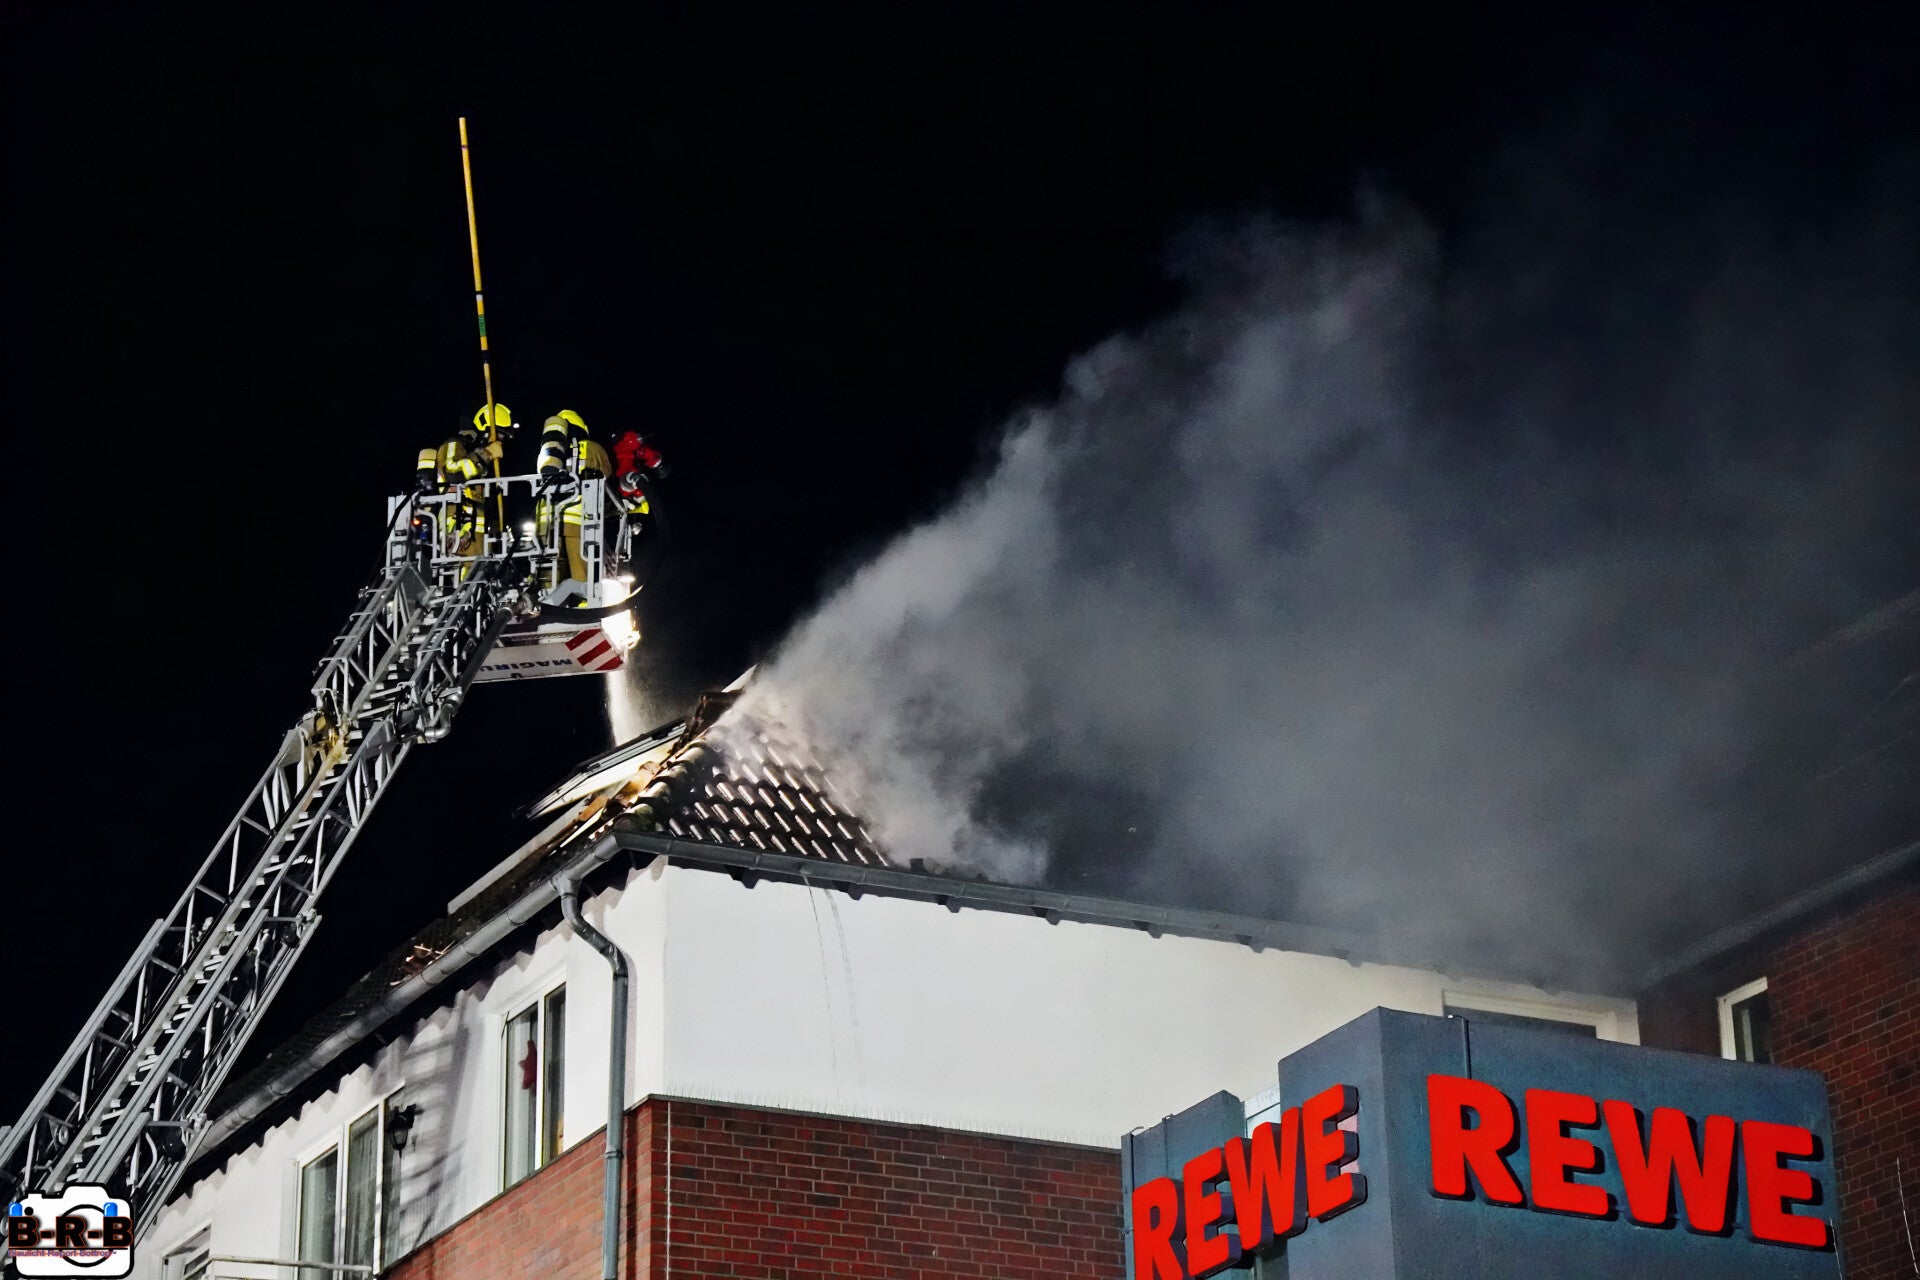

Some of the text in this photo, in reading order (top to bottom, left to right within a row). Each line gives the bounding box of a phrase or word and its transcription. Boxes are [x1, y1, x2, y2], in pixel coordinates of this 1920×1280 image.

[481, 658, 573, 672] MAGIRU
[1132, 1083, 1355, 1280] REWE
[1427, 1074, 1828, 1248] REWE
